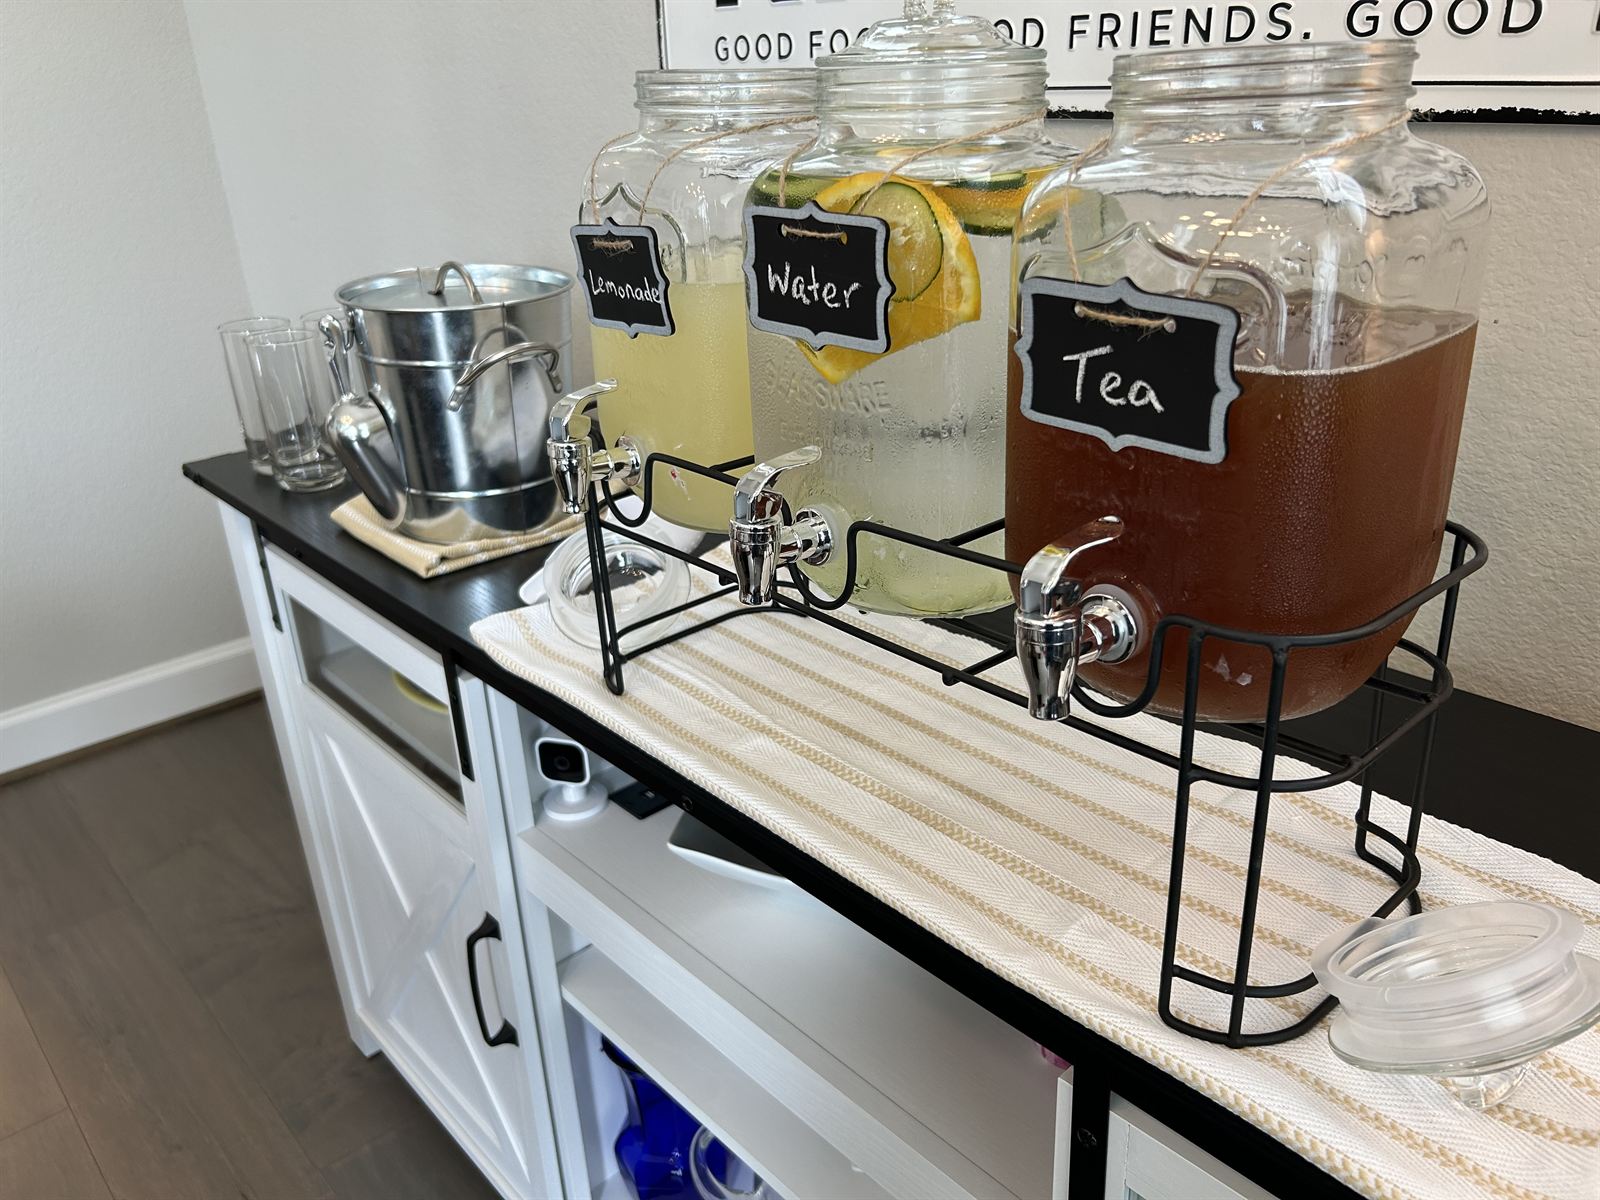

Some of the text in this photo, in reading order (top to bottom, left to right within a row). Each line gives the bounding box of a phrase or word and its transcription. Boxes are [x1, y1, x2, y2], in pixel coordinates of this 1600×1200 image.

[714, 32, 793, 62] GOOD
[809, 27, 870, 59] FO
[1068, 2, 1311, 50] FRIENDS.
[1346, 0, 1543, 38] GOOD
[588, 269, 662, 304] Lemonade
[767, 261, 862, 310] Water
[1062, 345, 1165, 413] Tea
